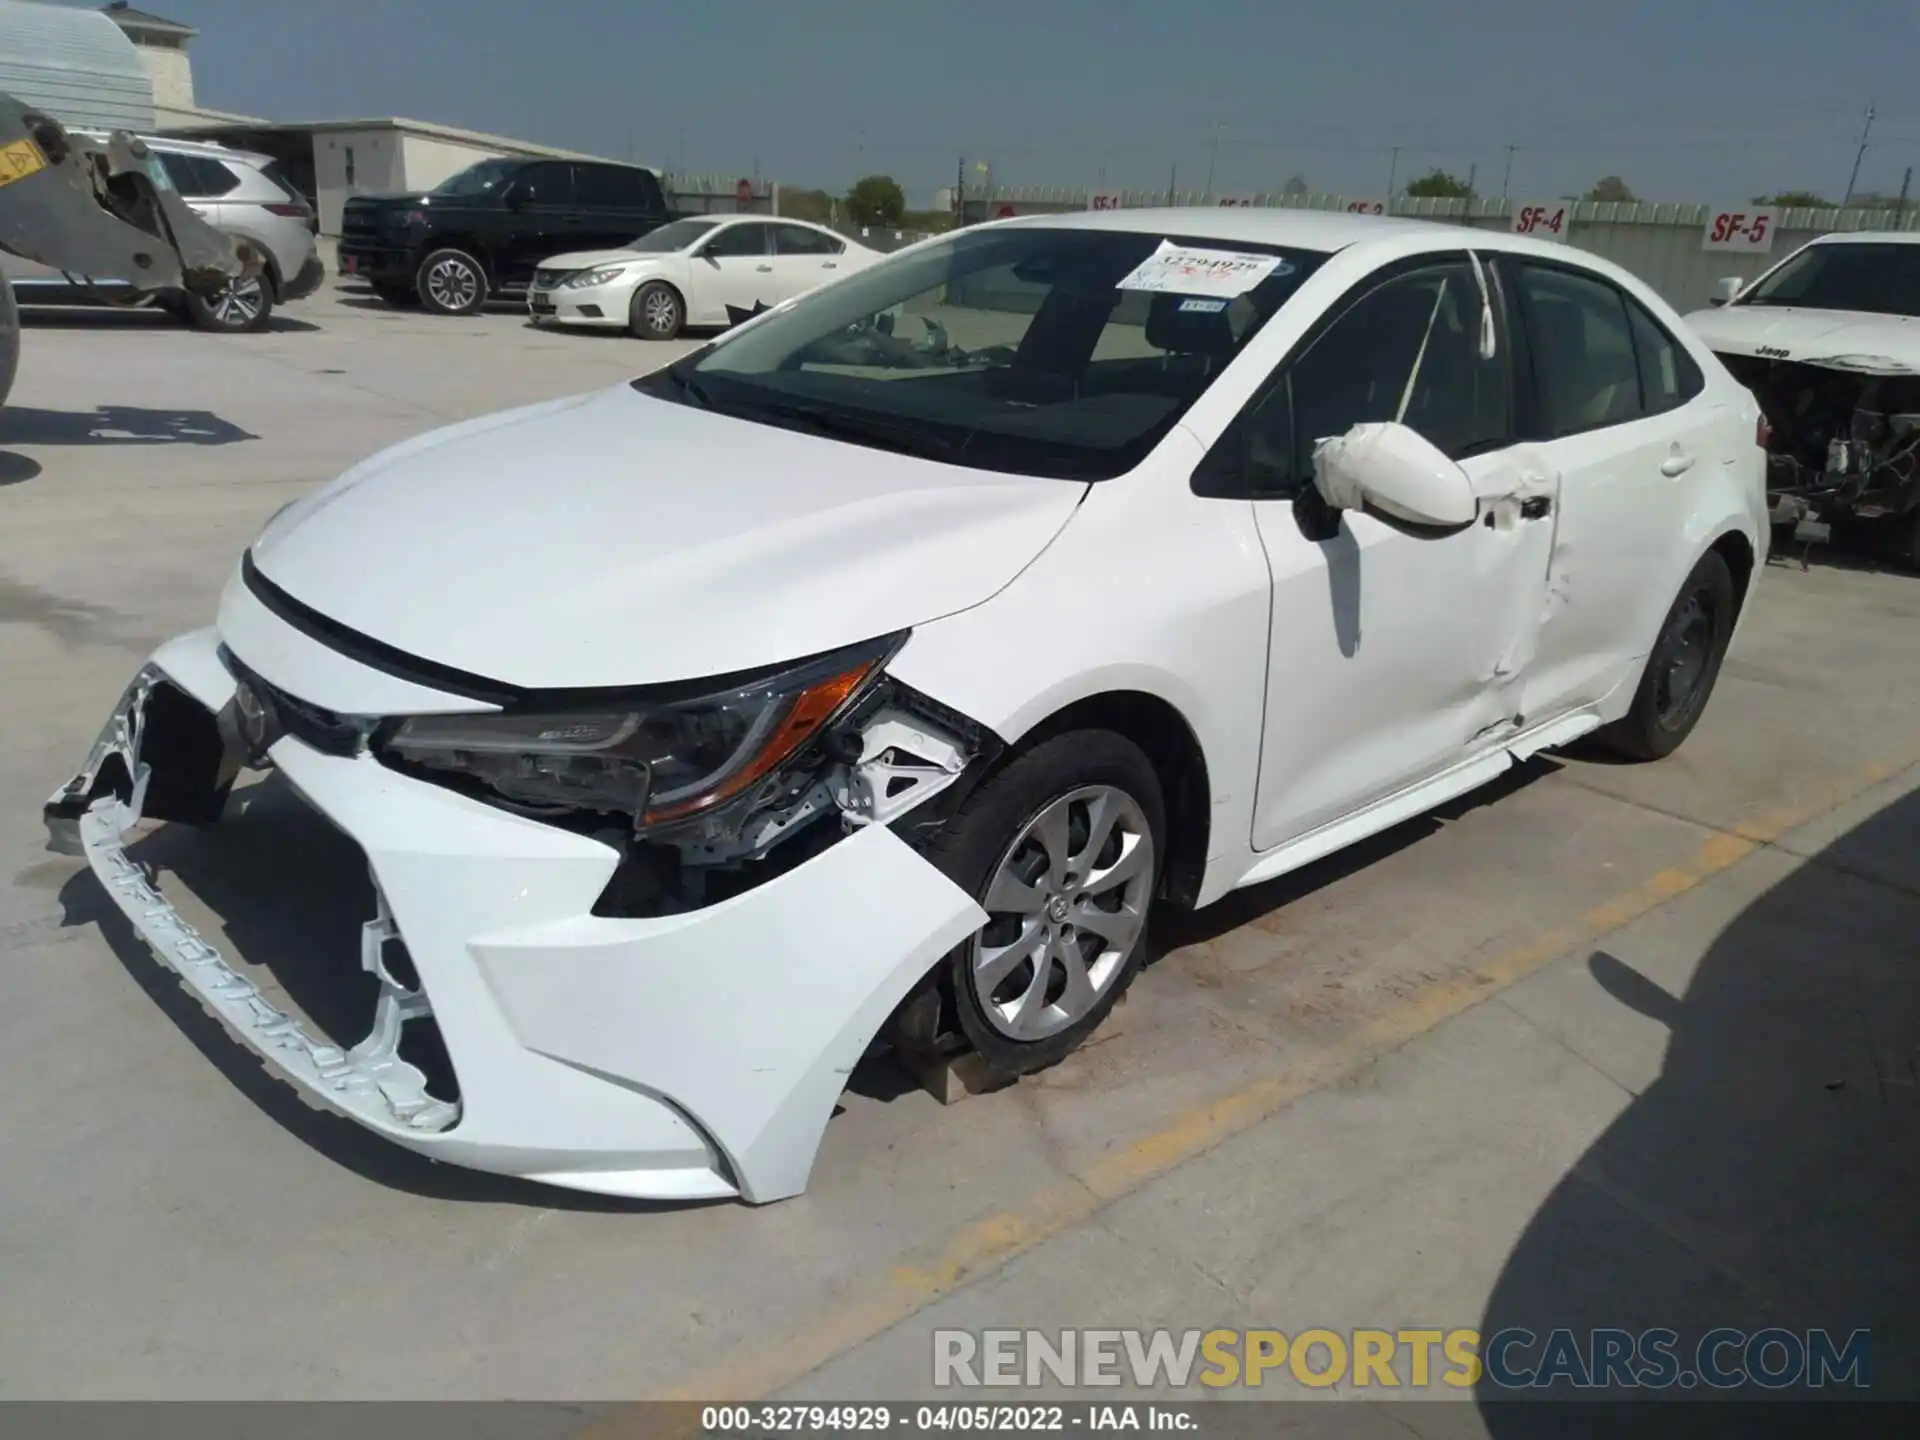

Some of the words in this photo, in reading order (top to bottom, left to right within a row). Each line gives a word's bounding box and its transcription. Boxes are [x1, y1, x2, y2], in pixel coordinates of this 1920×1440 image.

[1516, 206, 1564, 232] SF-4
[1710, 213, 1769, 243] SF-5
[1754, 344, 1792, 358] Jeep
